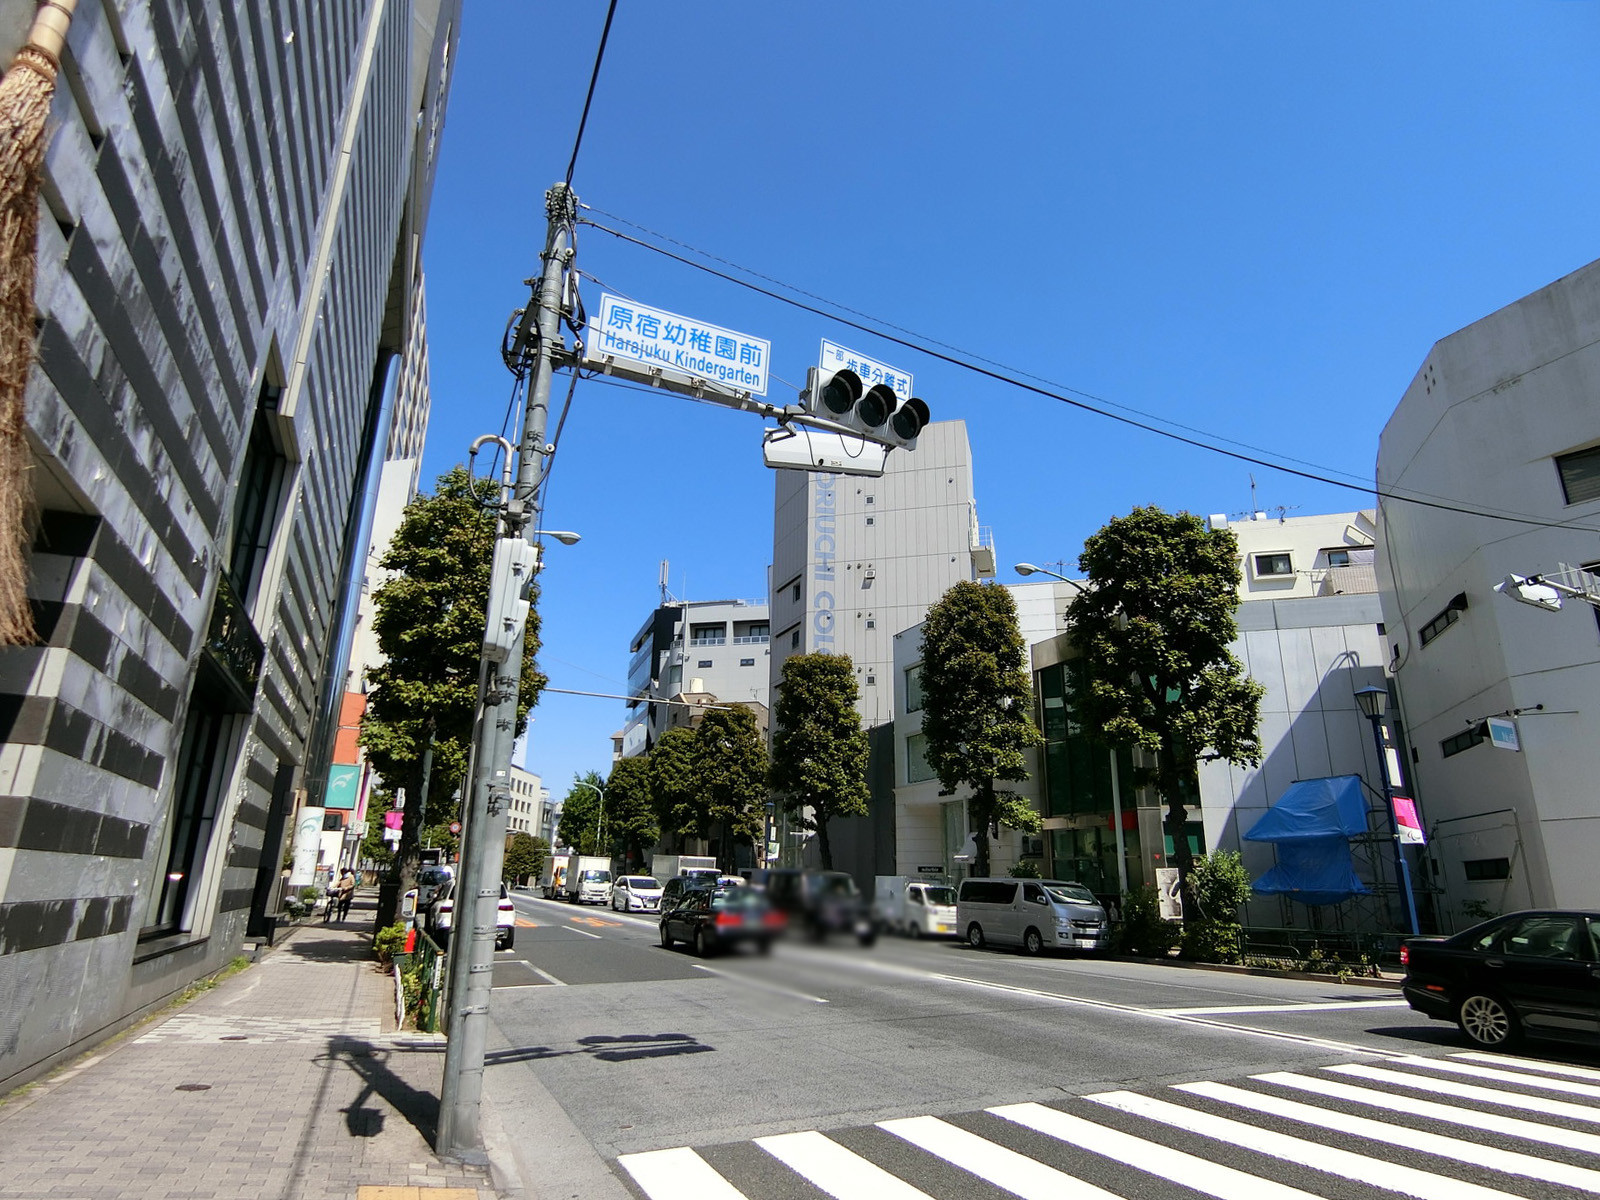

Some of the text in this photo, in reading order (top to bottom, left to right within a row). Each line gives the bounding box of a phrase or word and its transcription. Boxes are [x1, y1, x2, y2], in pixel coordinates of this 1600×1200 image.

[605, 330, 760, 387] Harajuku Kindergarten
[607, 305, 762, 367] 原宿幼稚園前
[846, 359, 908, 395] 歩車分離式
